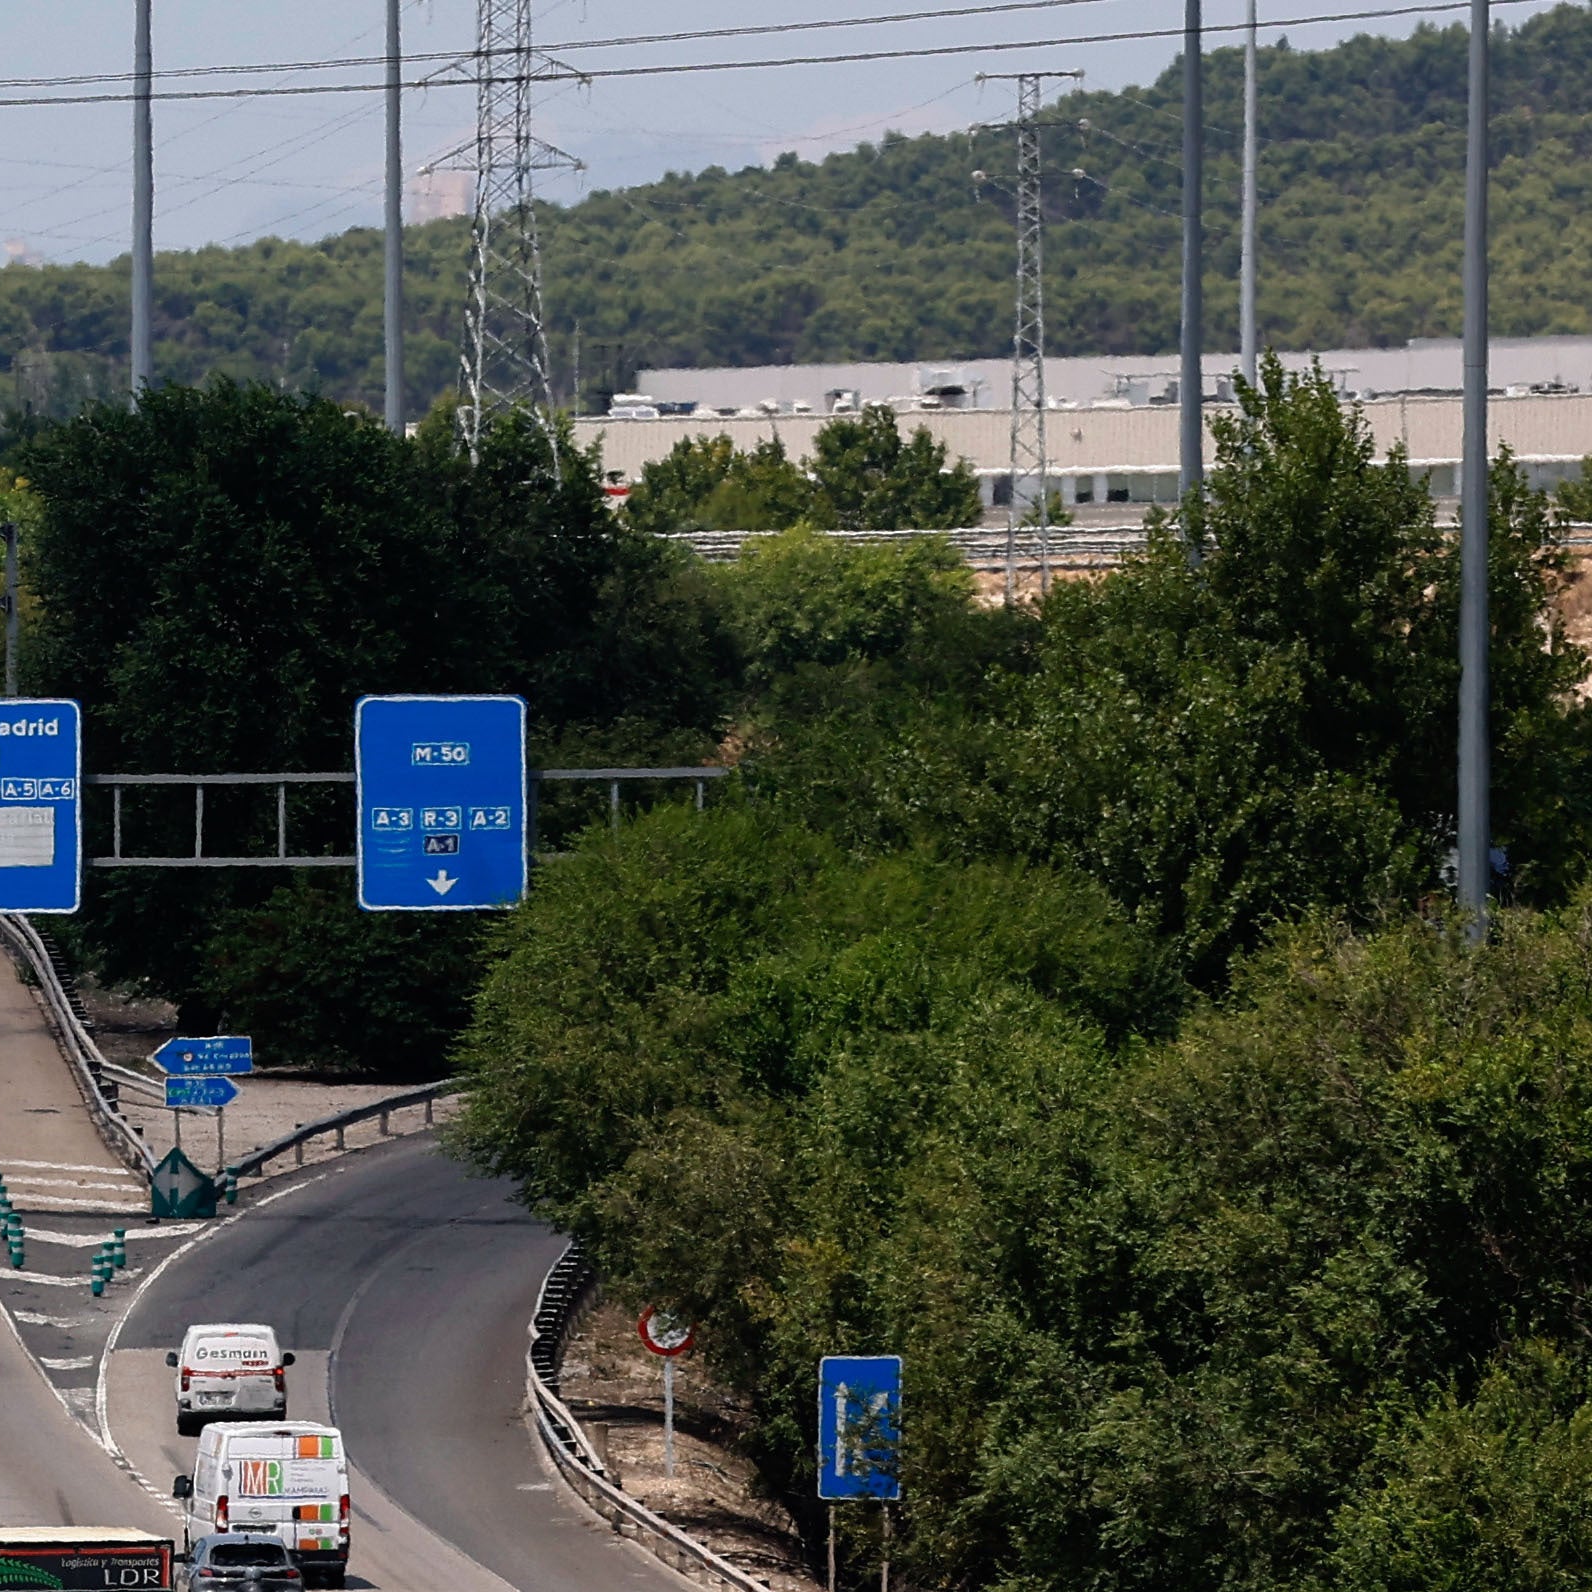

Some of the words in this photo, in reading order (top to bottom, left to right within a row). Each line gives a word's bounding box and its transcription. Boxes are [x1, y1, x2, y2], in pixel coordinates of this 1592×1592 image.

[415, 746, 466, 761] M-50
[5, 783, 34, 796] A-5
[42, 782, 71, 796] A-6
[376, 811, 410, 826] A-3
[424, 810, 458, 826] R-3
[472, 810, 507, 826] A-2
[427, 838, 455, 852] A-1
[111, 1557, 159, 1569] Transportes
[104, 1568, 160, 1585] LDR
